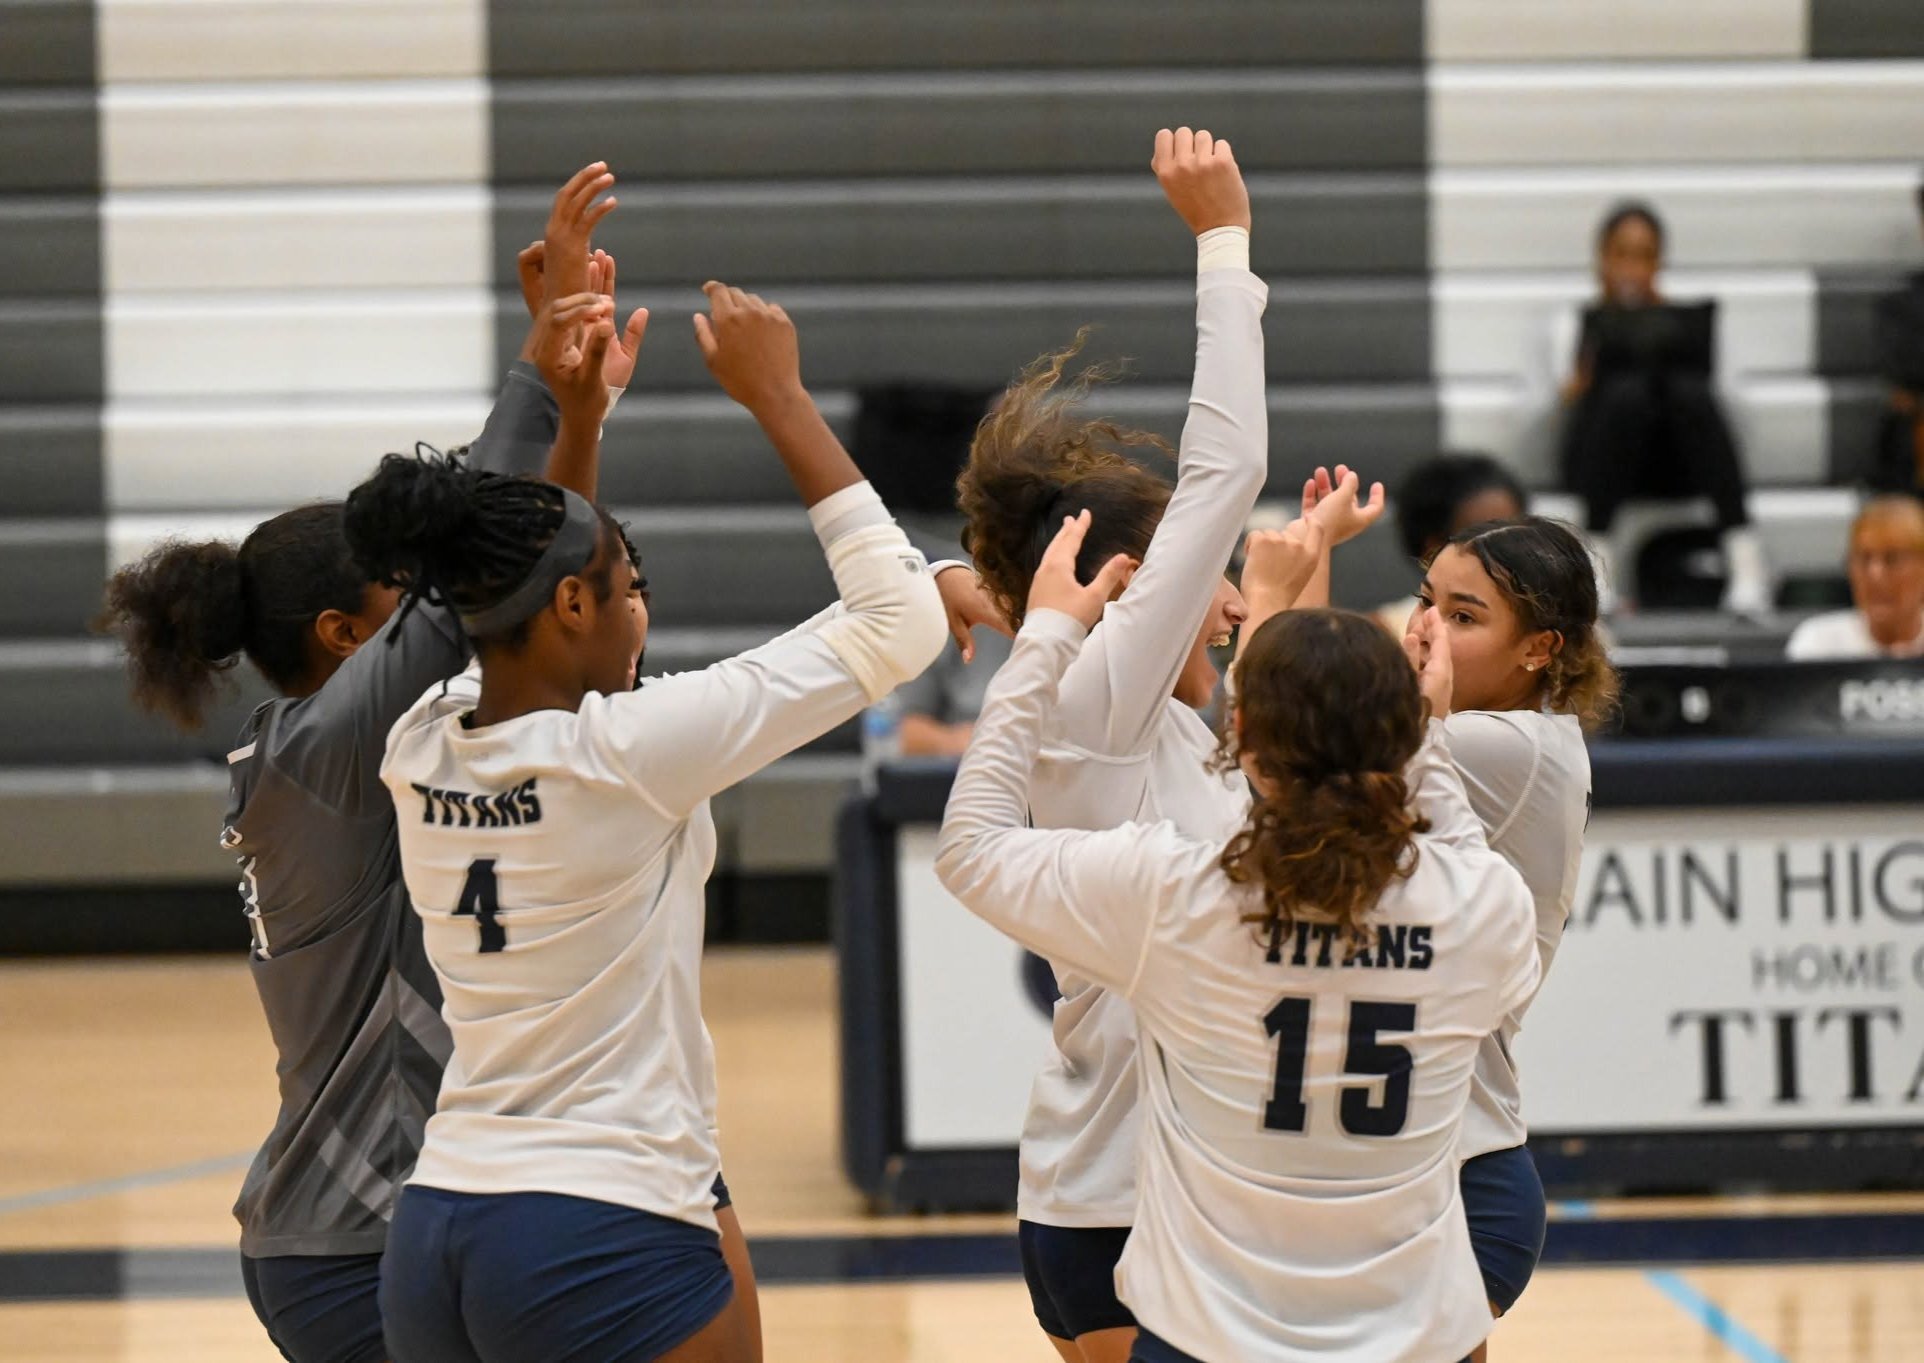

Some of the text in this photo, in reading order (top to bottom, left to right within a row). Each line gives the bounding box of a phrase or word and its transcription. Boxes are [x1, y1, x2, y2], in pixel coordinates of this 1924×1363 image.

[410, 776, 542, 827] TITANS
[451, 858, 507, 953] 4
[1565, 847, 1741, 927] AIN
[1261, 917, 1434, 970] TITANS
[1750, 943, 1900, 992] HOME
[1262, 996, 1417, 1137] 15
[1667, 1005, 1924, 1105] TIT
